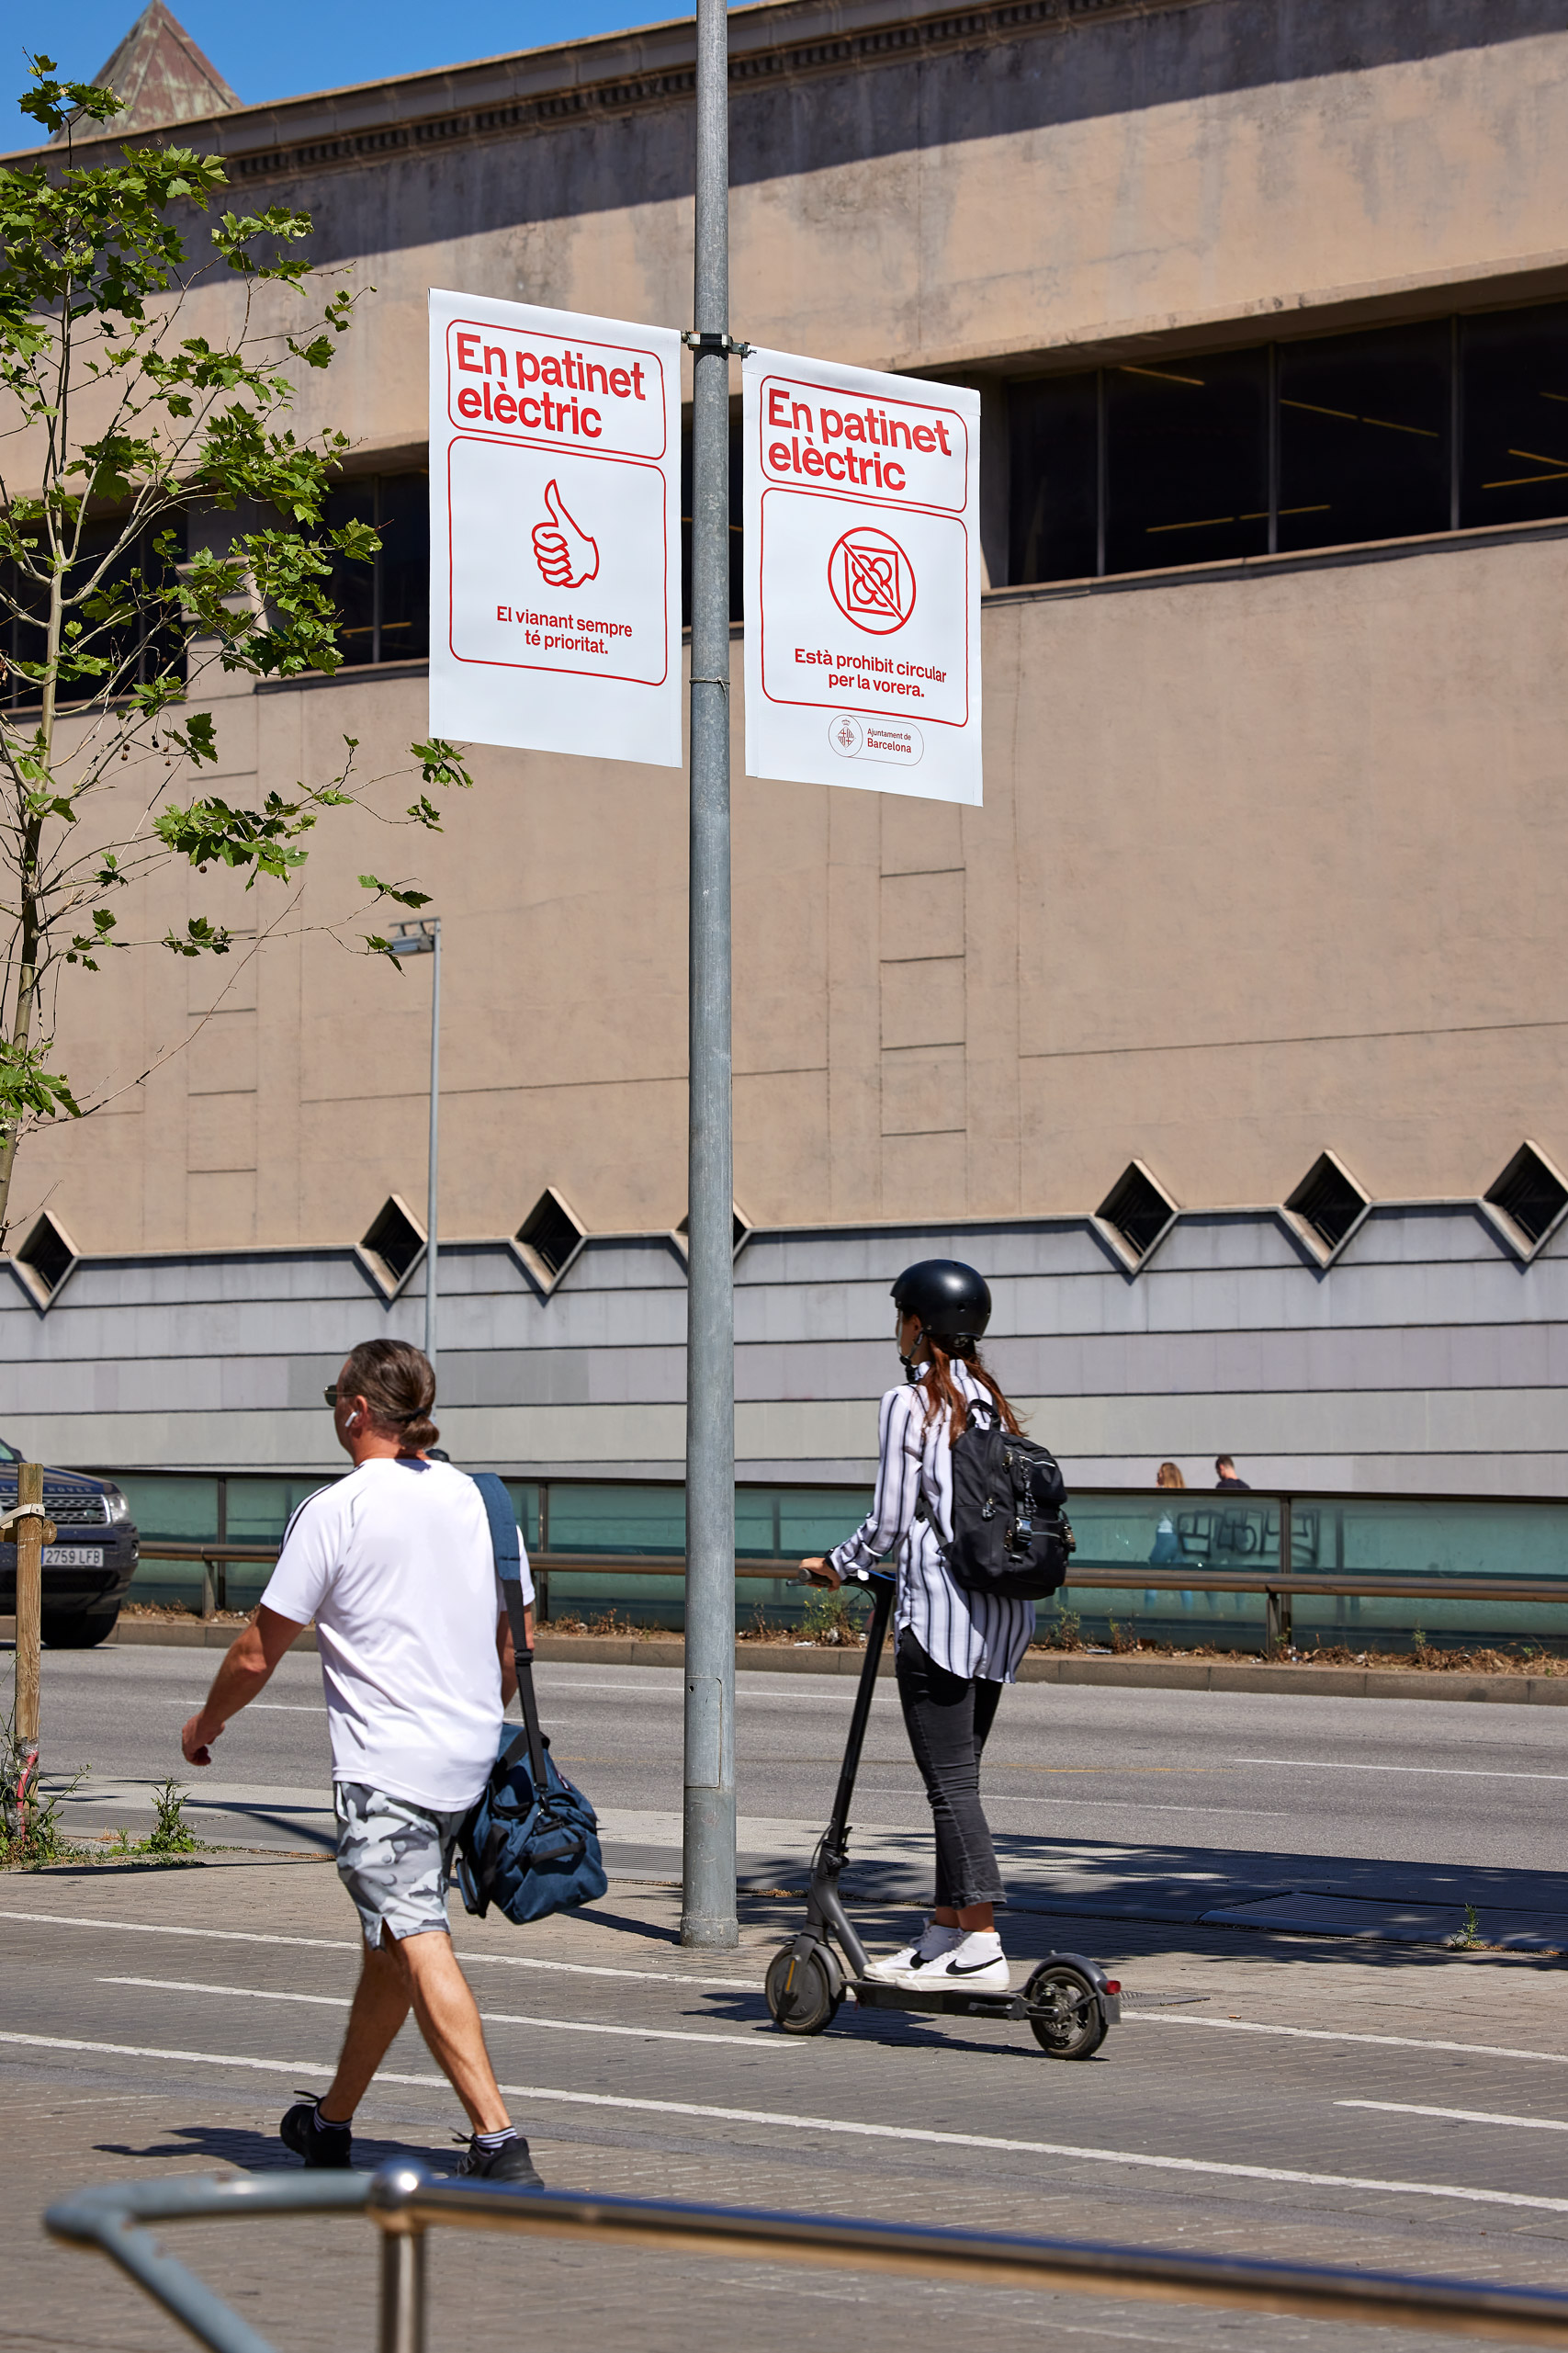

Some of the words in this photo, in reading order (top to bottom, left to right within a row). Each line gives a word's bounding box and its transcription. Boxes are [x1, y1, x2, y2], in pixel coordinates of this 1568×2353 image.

[456, 332, 508, 379] En
[515, 349, 647, 402] patinet
[457, 381, 603, 438] elèctric
[768, 387, 814, 434] En
[819, 407, 952, 457] patinet
[768, 436, 907, 492] elèctric
[496, 605, 513, 623] El
[515, 608, 574, 630] vianant
[576, 618, 633, 639] sempre
[524, 628, 541, 647] té
[544, 633, 609, 655] prioritat.
[795, 648, 833, 666] Està
[836, 654, 895, 674] prohibit
[896, 661, 947, 684] circular
[828, 673, 855, 689] per
[857, 673, 871, 691] la
[872, 679, 925, 698] vorera.
[867, 728, 903, 739] Ajuntament
[867, 737, 912, 753] Barcelona
[46, 1550, 75, 1564] 2759
[79, 1550, 100, 1564] LFB
